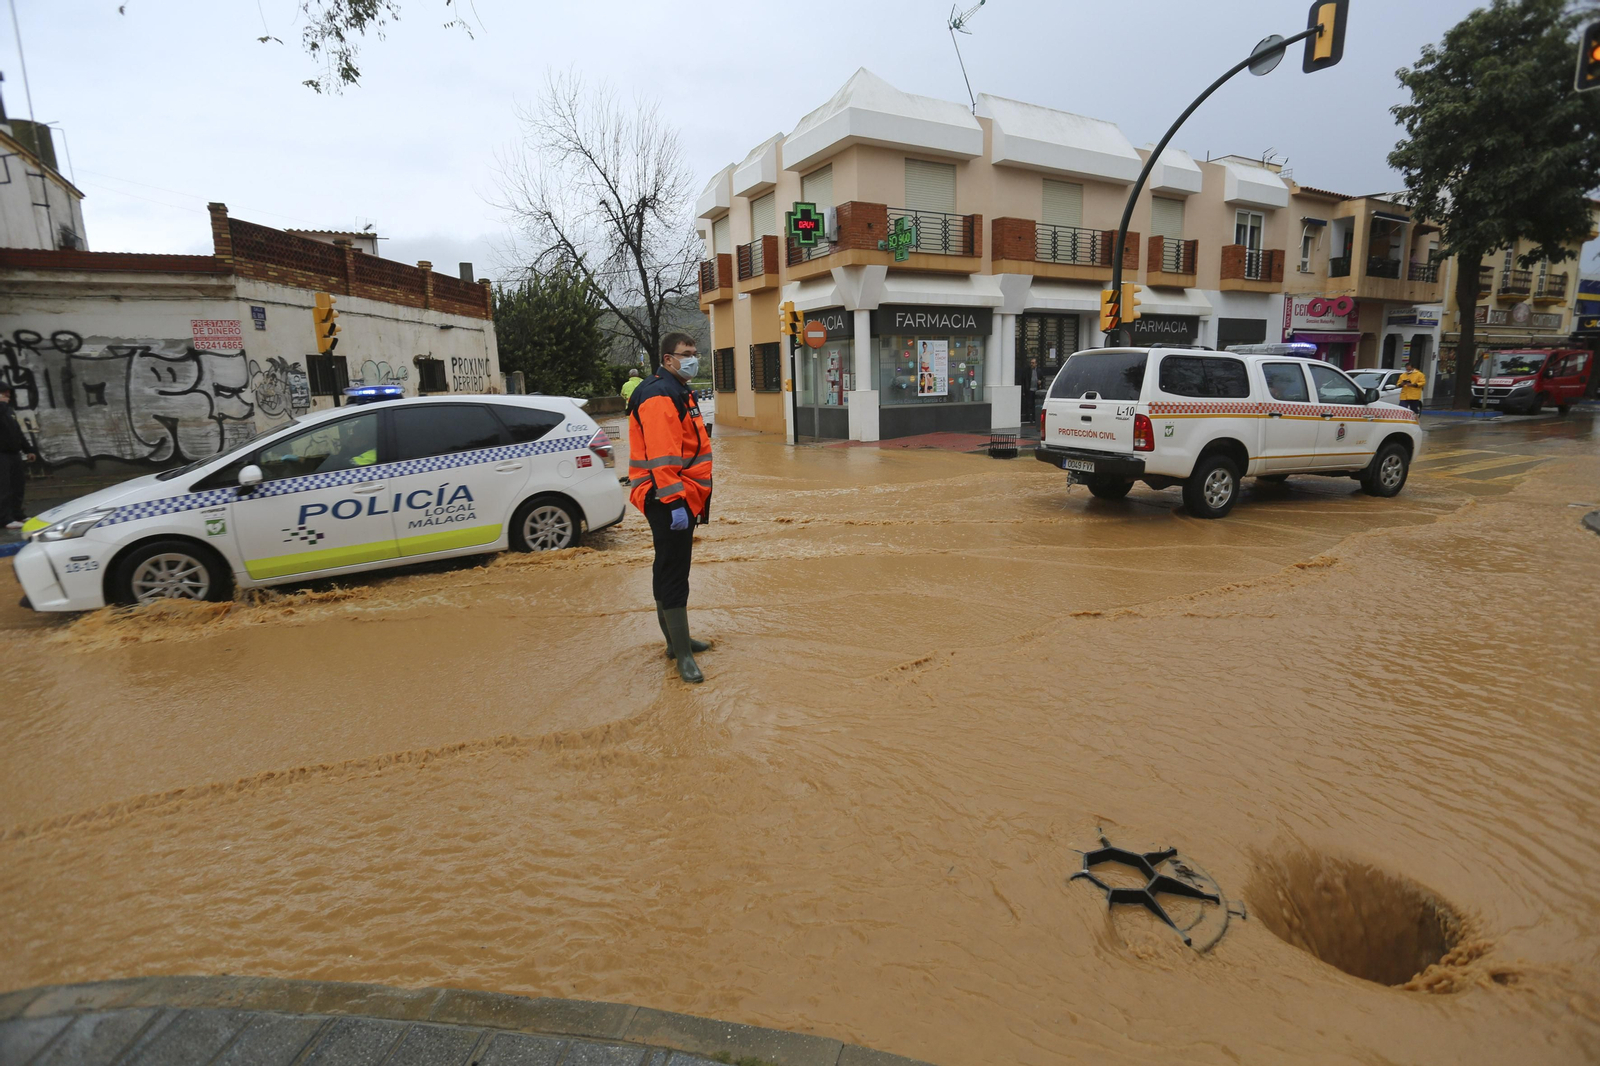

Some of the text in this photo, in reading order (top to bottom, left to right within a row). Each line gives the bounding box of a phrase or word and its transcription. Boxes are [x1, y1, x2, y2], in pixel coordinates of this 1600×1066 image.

[191, 320, 241, 328] PRESTAMOS
[896, 312, 977, 329] FARMACIA
[1134, 320, 1188, 333] FARMACIA
[194, 341, 244, 350] 652414865
[453, 375, 484, 393] DERRIBO
[1116, 406, 1135, 417] L-10
[1058, 428, 1117, 441] PROTECCIÓN CIVIL
[1067, 460, 1094, 471] 0049 FVX
[298, 482, 474, 525] POLICÍA
[425, 502, 475, 517] LOCAL
[408, 512, 477, 529] MÁLAGA
